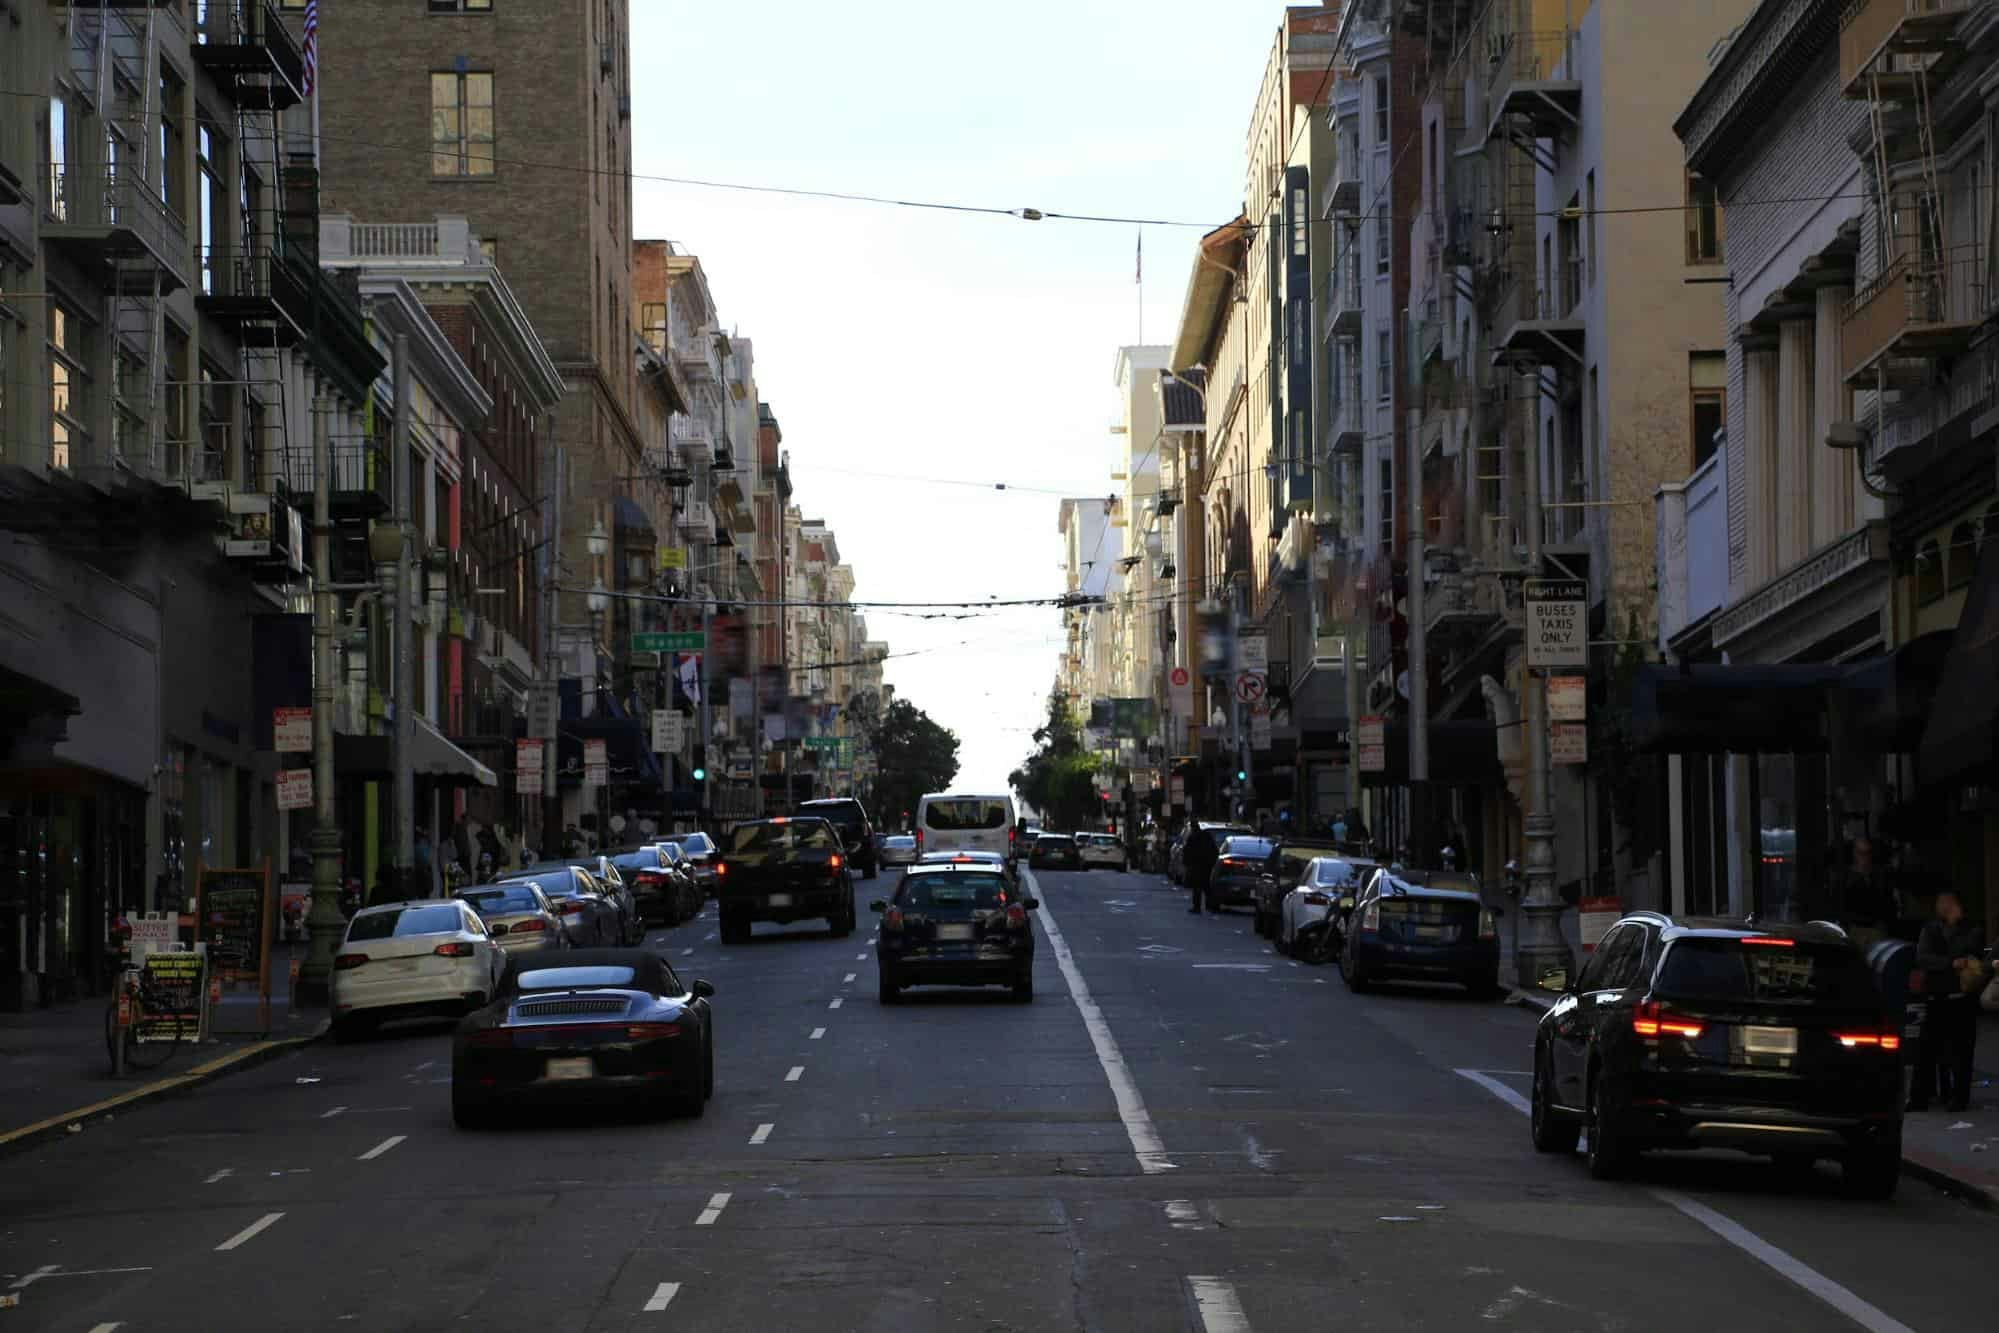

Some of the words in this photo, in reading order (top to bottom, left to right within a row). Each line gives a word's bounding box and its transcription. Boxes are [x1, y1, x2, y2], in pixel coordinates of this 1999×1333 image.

[1558, 586, 1584, 597] LANE
[1536, 604, 1577, 617] BUSES
[1540, 618, 1574, 630] TAXIS
[1540, 631, 1572, 644] ONLY
